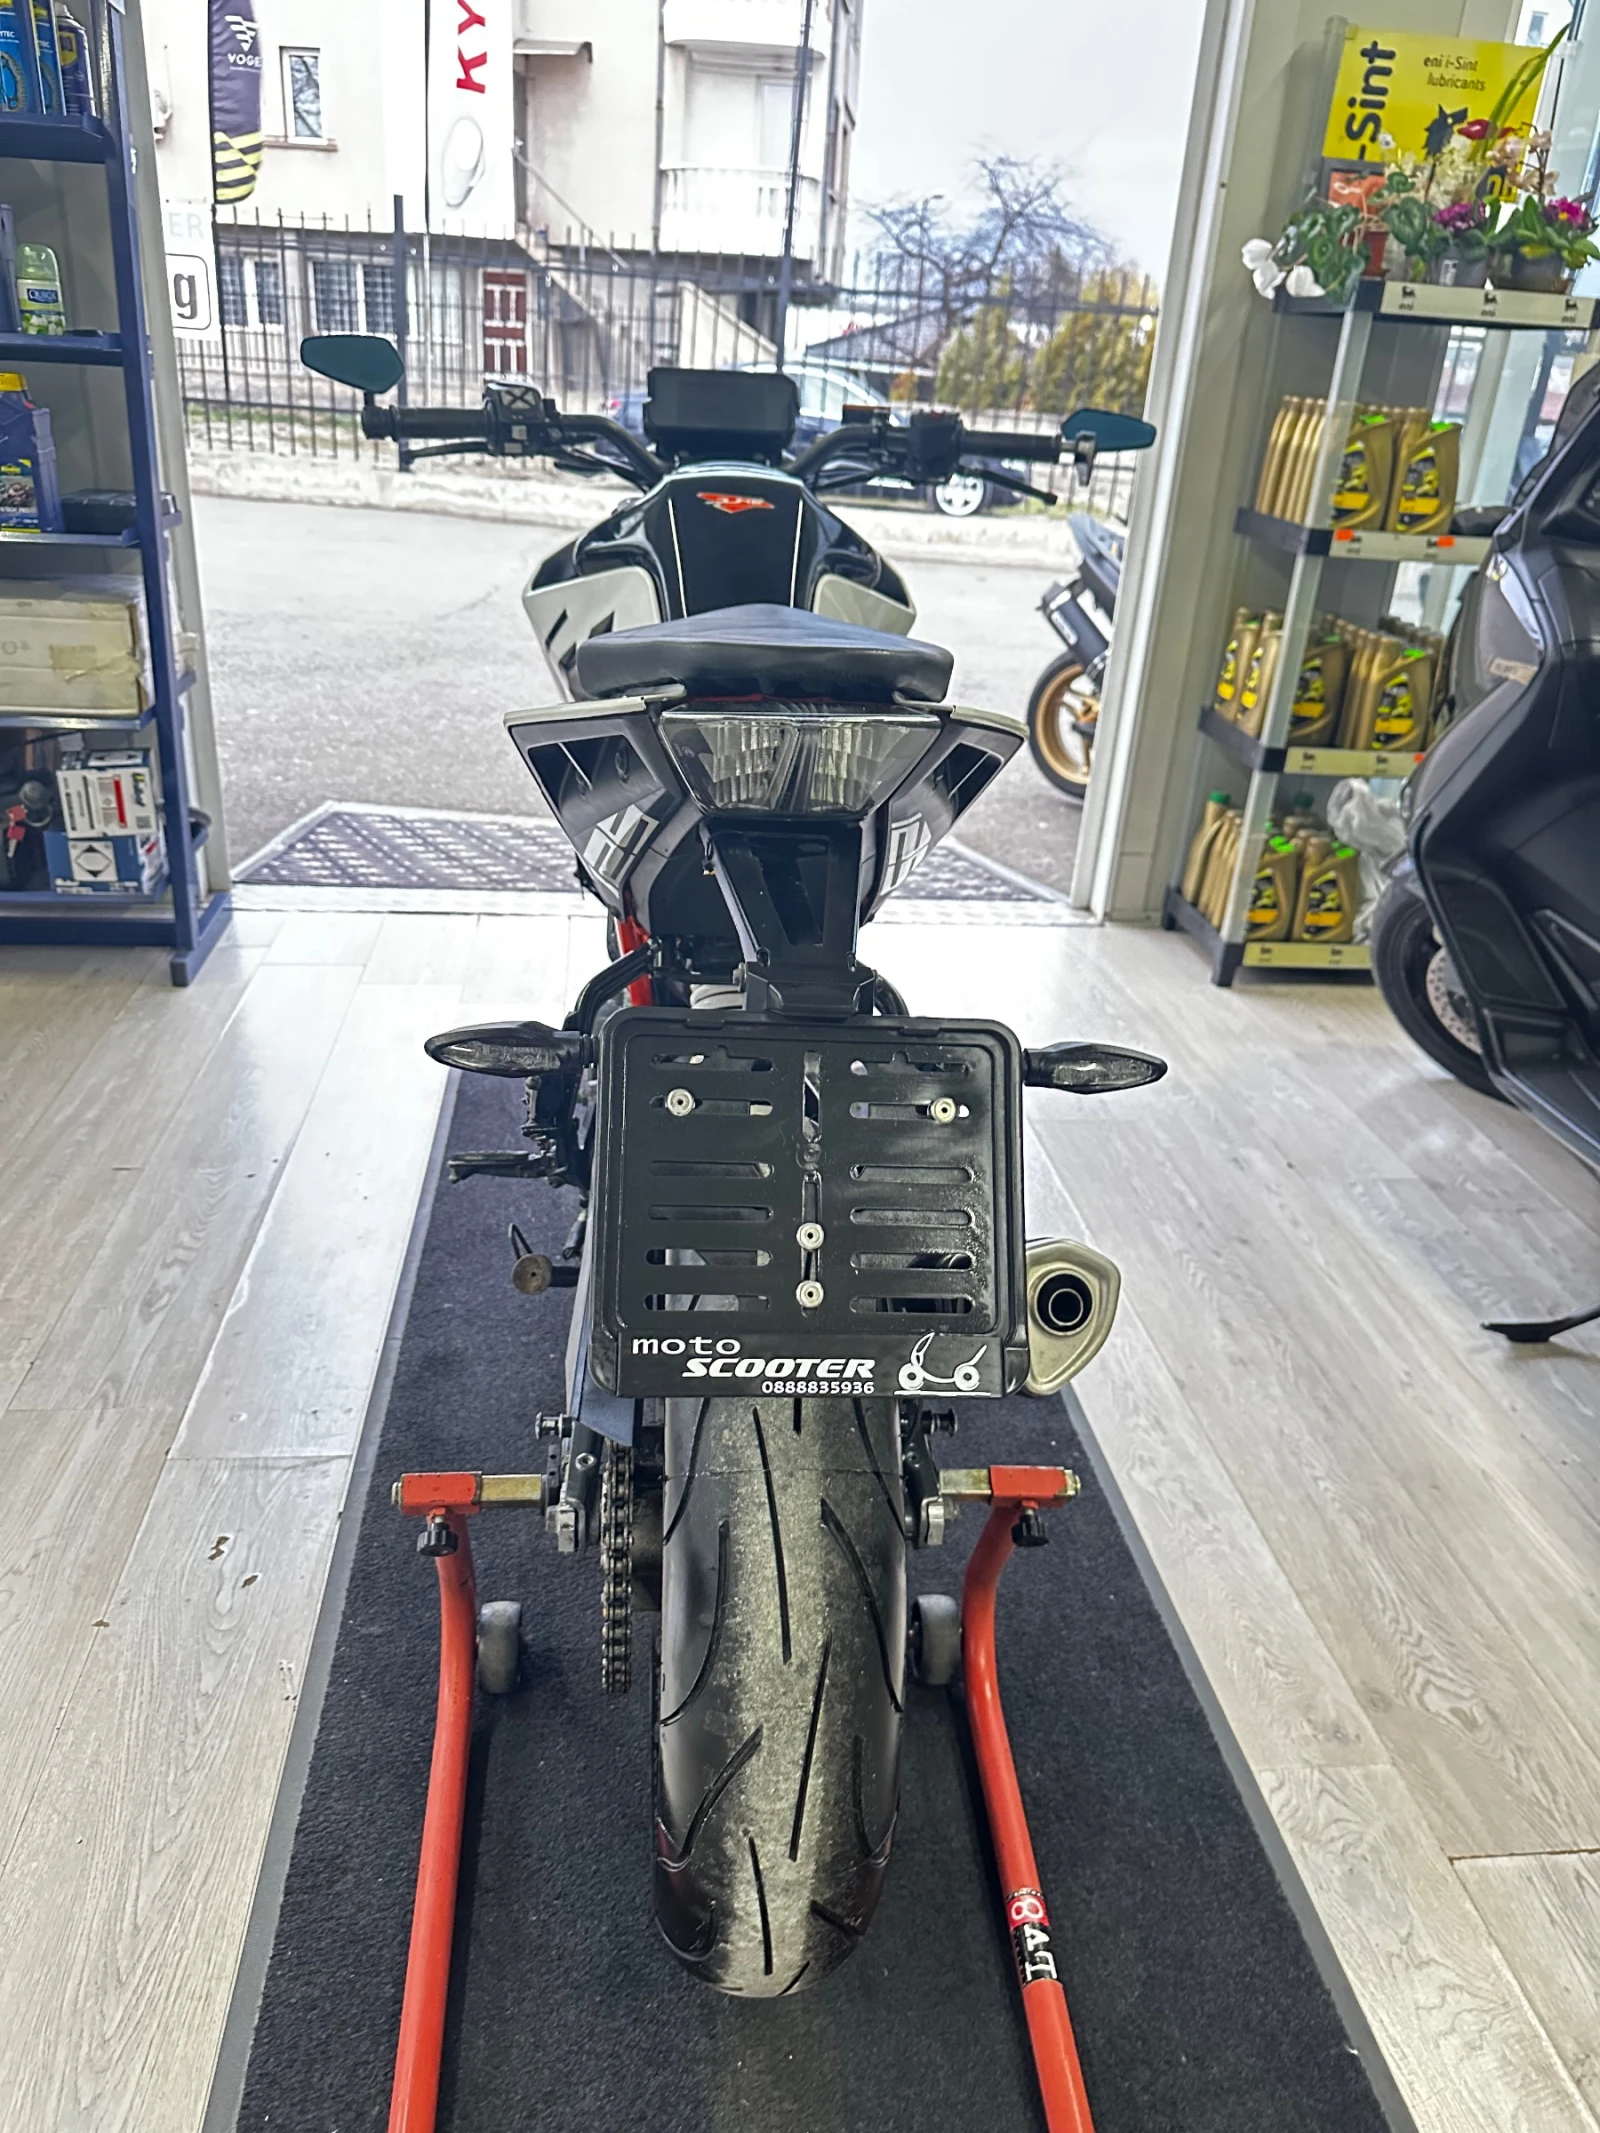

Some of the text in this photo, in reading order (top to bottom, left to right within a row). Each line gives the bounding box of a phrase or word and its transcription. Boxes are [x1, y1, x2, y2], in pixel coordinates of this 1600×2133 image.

[457, 0, 487, 94] KY
[1423, 54, 1479, 71] eni i-Sint
[1427, 73, 1486, 91] lubricants
[632, 1335, 741, 1355] moto
[682, 1357, 876, 1379] SCOOTER
[761, 1380, 875, 1395] 0888835936
